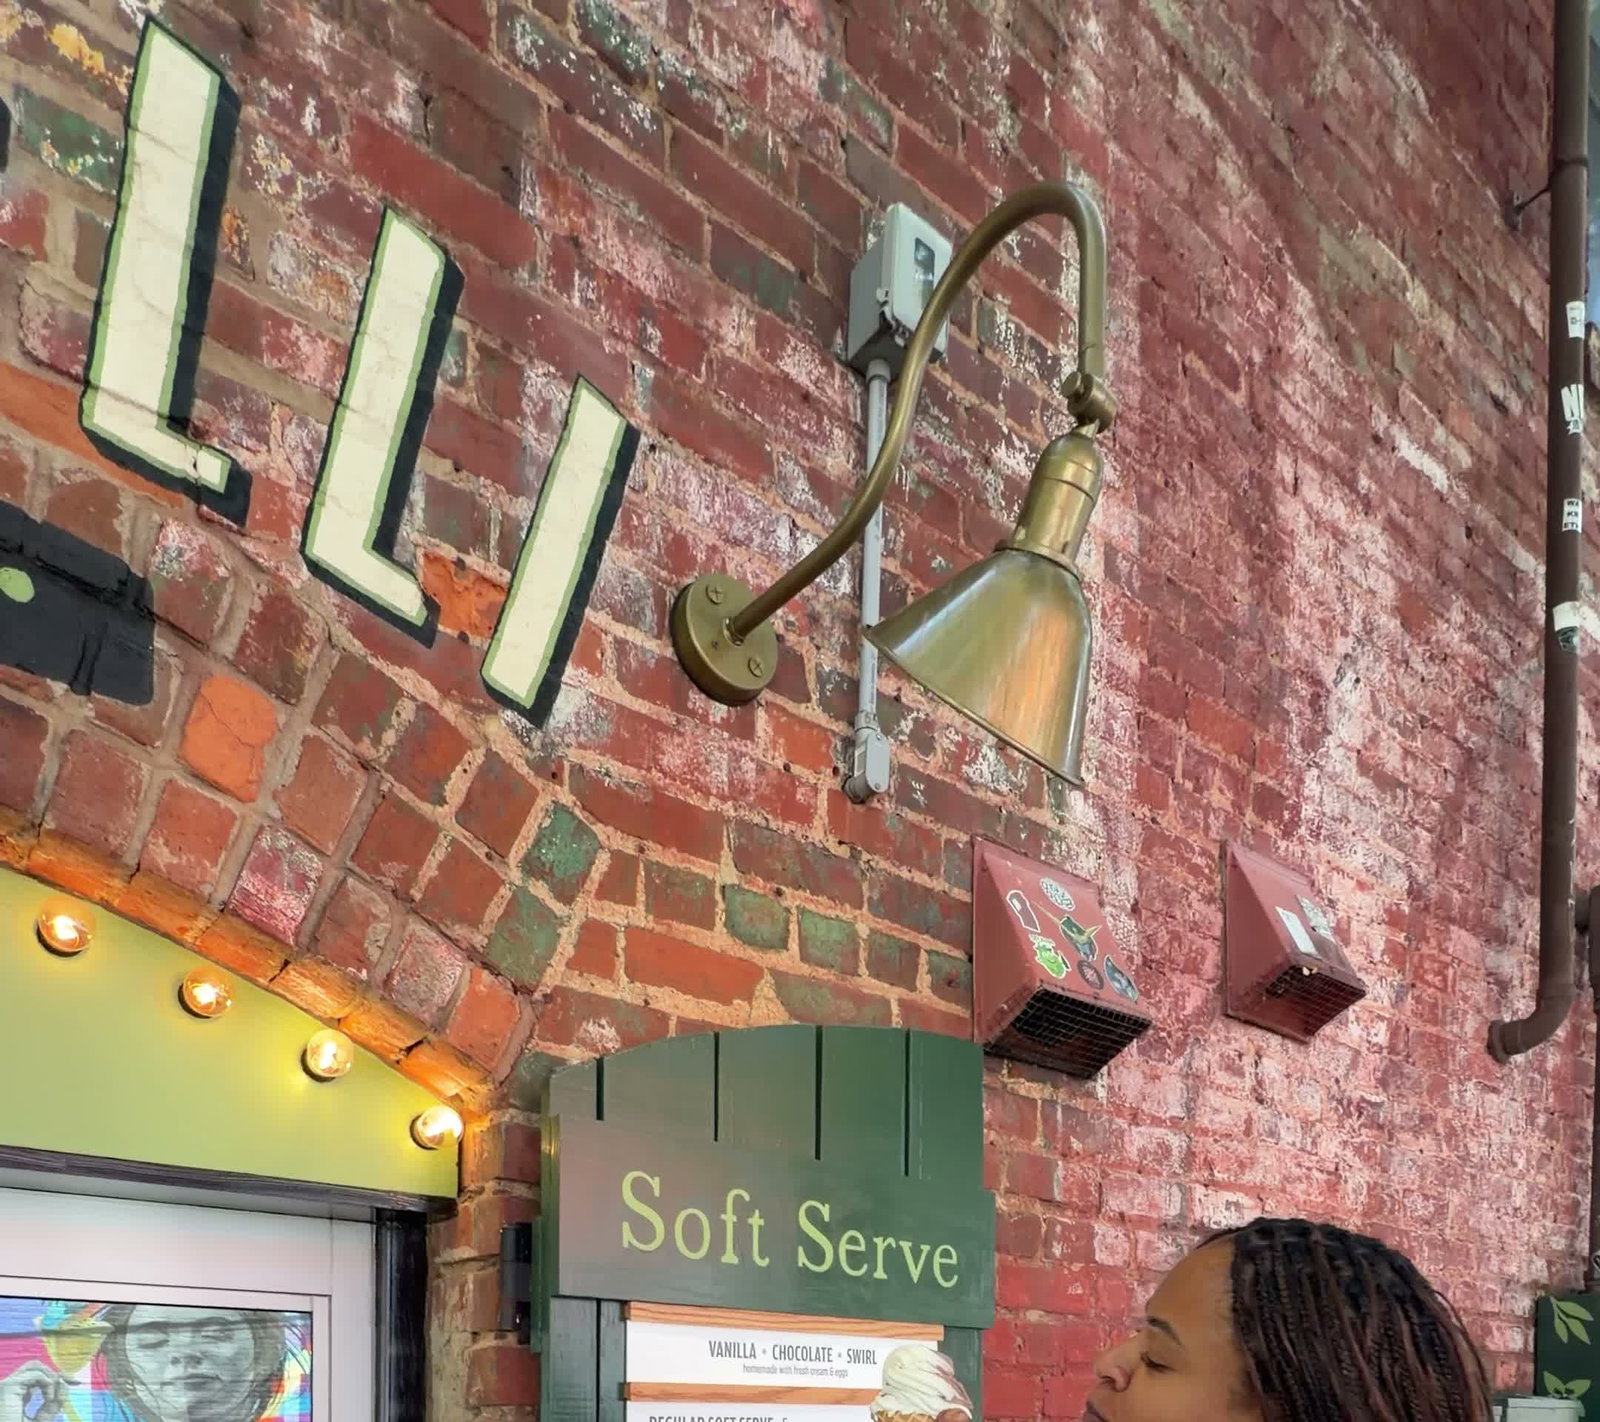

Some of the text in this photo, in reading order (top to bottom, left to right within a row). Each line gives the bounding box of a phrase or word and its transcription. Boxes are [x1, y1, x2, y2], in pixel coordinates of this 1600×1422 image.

[621, 1170, 960, 1289] Soft Serve
[708, 1340, 877, 1365] VANILLA CHOCOLATE SWIRL
[779, 1366, 793, 1375] with
[793, 1366, 810, 1376] fresh
[835, 1368, 848, 1379] eggs
